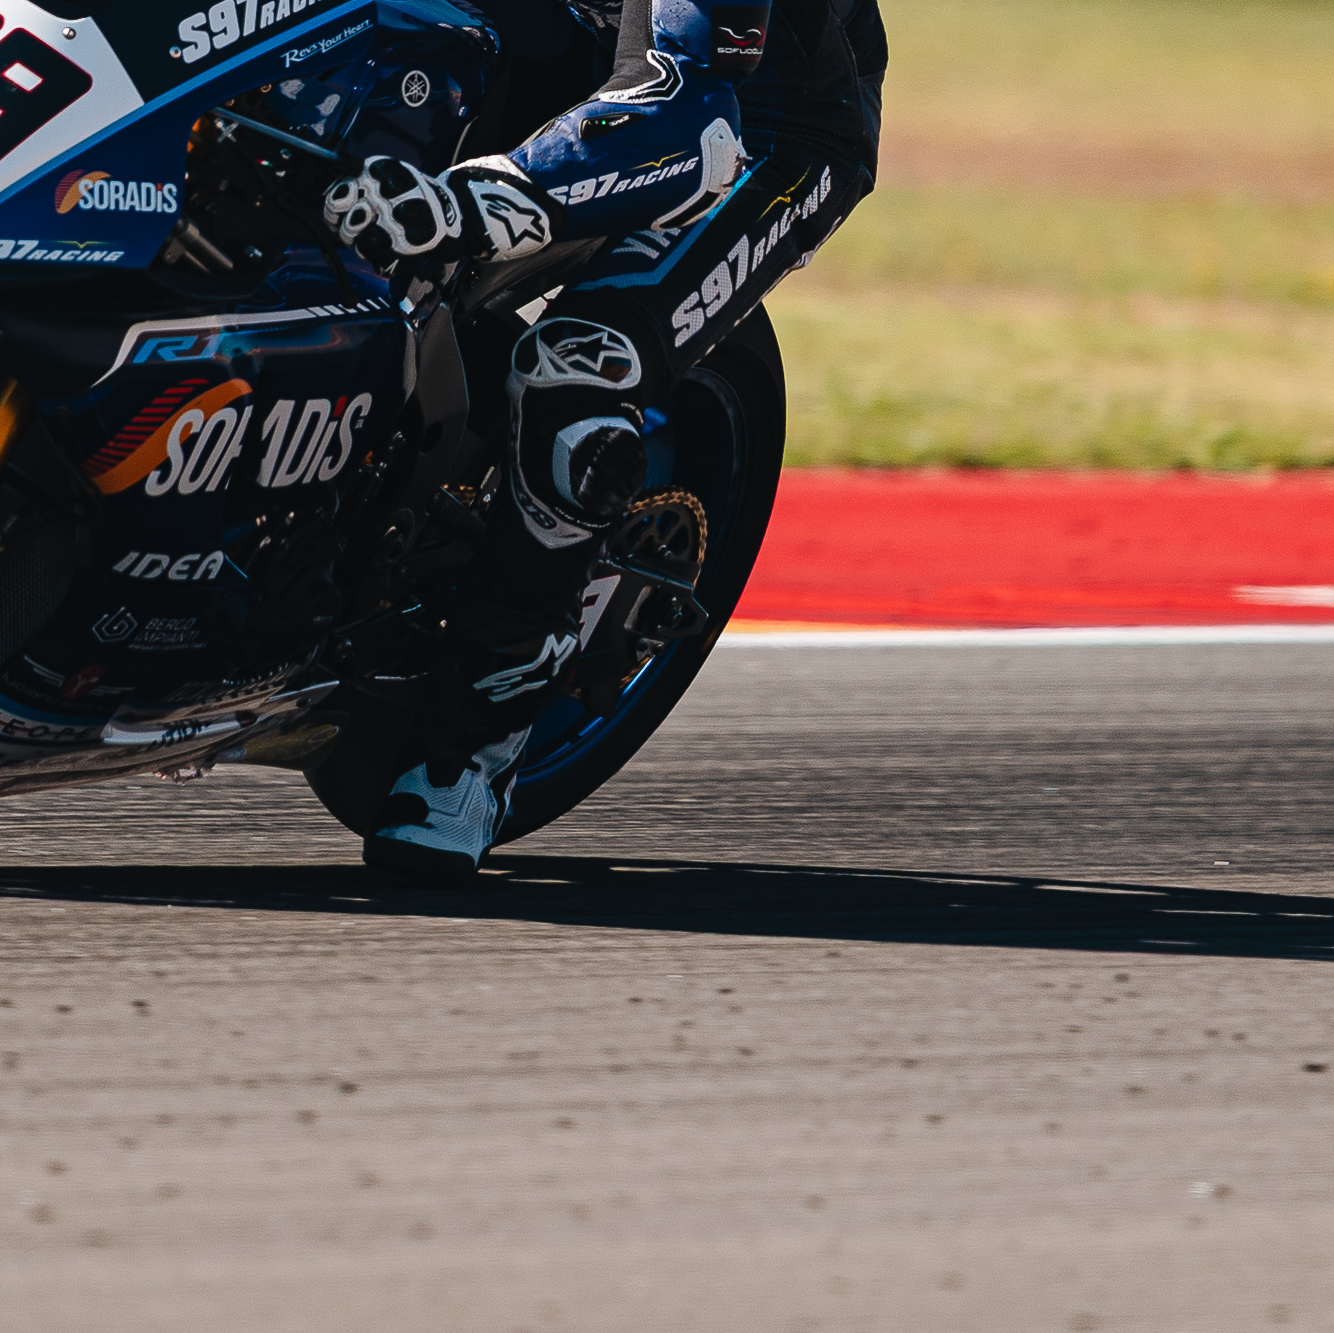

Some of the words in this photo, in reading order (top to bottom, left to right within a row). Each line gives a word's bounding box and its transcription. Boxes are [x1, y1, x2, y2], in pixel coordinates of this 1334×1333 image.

[280, 43, 317, 68] Revs
[318, 33, 342, 53] Your
[344, 19, 370, 38] Heart
[132, 331, 225, 365] R1
[113, 550, 224, 581] IDEA
